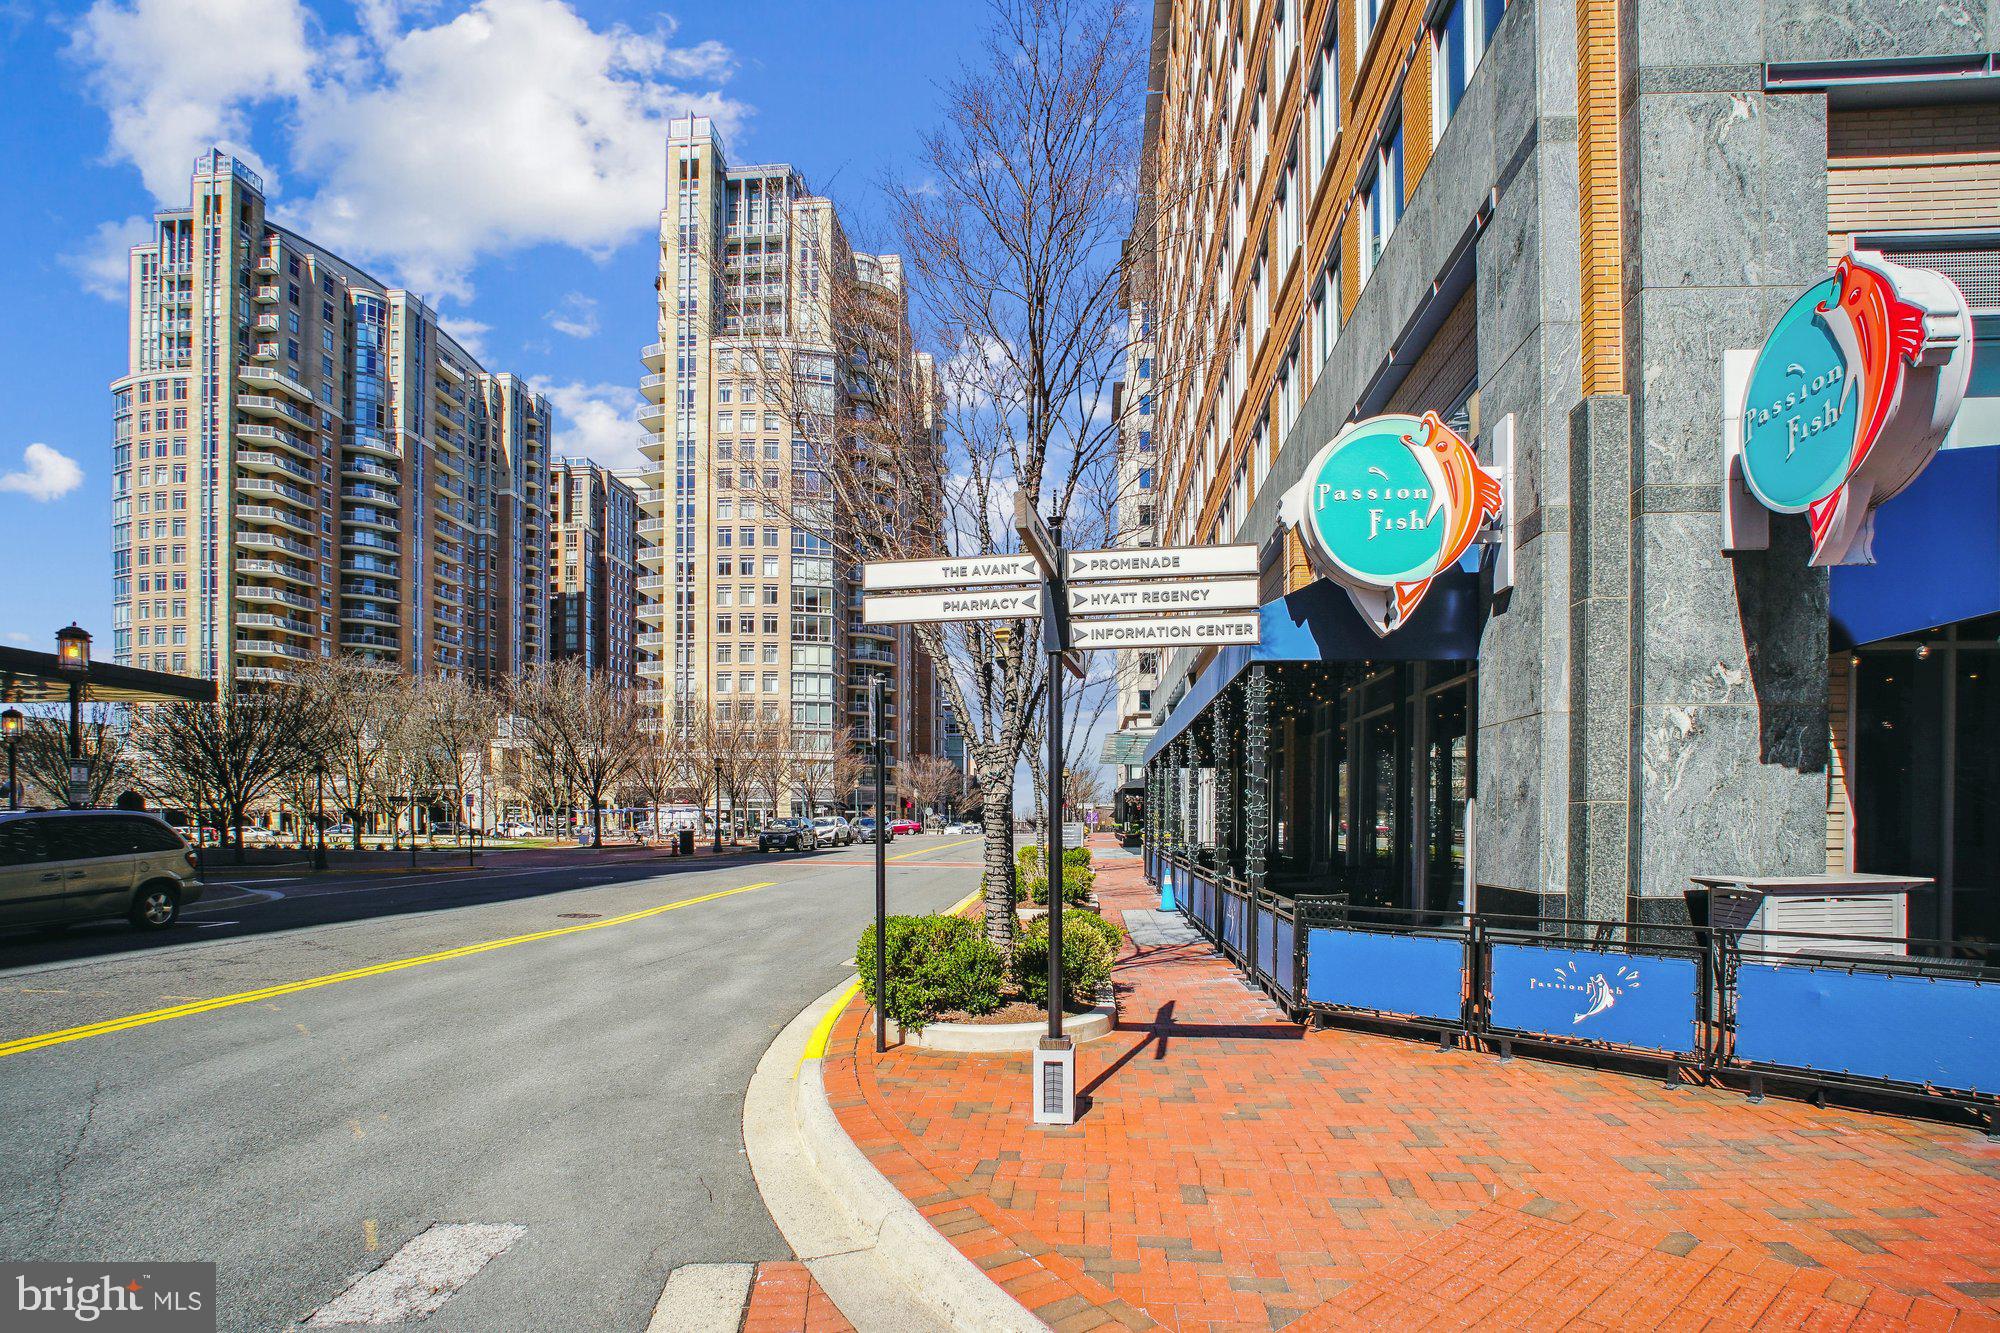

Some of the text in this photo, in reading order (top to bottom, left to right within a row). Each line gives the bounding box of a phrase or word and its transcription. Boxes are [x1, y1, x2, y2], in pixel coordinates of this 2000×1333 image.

[1744, 363, 1843, 448] Passion
[1785, 399, 1840, 463] Fish
[1317, 484, 1428, 512] Passion
[1368, 508, 1426, 541] Fish
[942, 562, 1020, 578] THE AVANT
[1090, 556, 1180, 571] PROMENADE
[943, 597, 1019, 613] PHARMACY
[1090, 588, 1211, 606] HYATT REGENCY
[1090, 623, 1253, 640] INFORMATION CENTER
